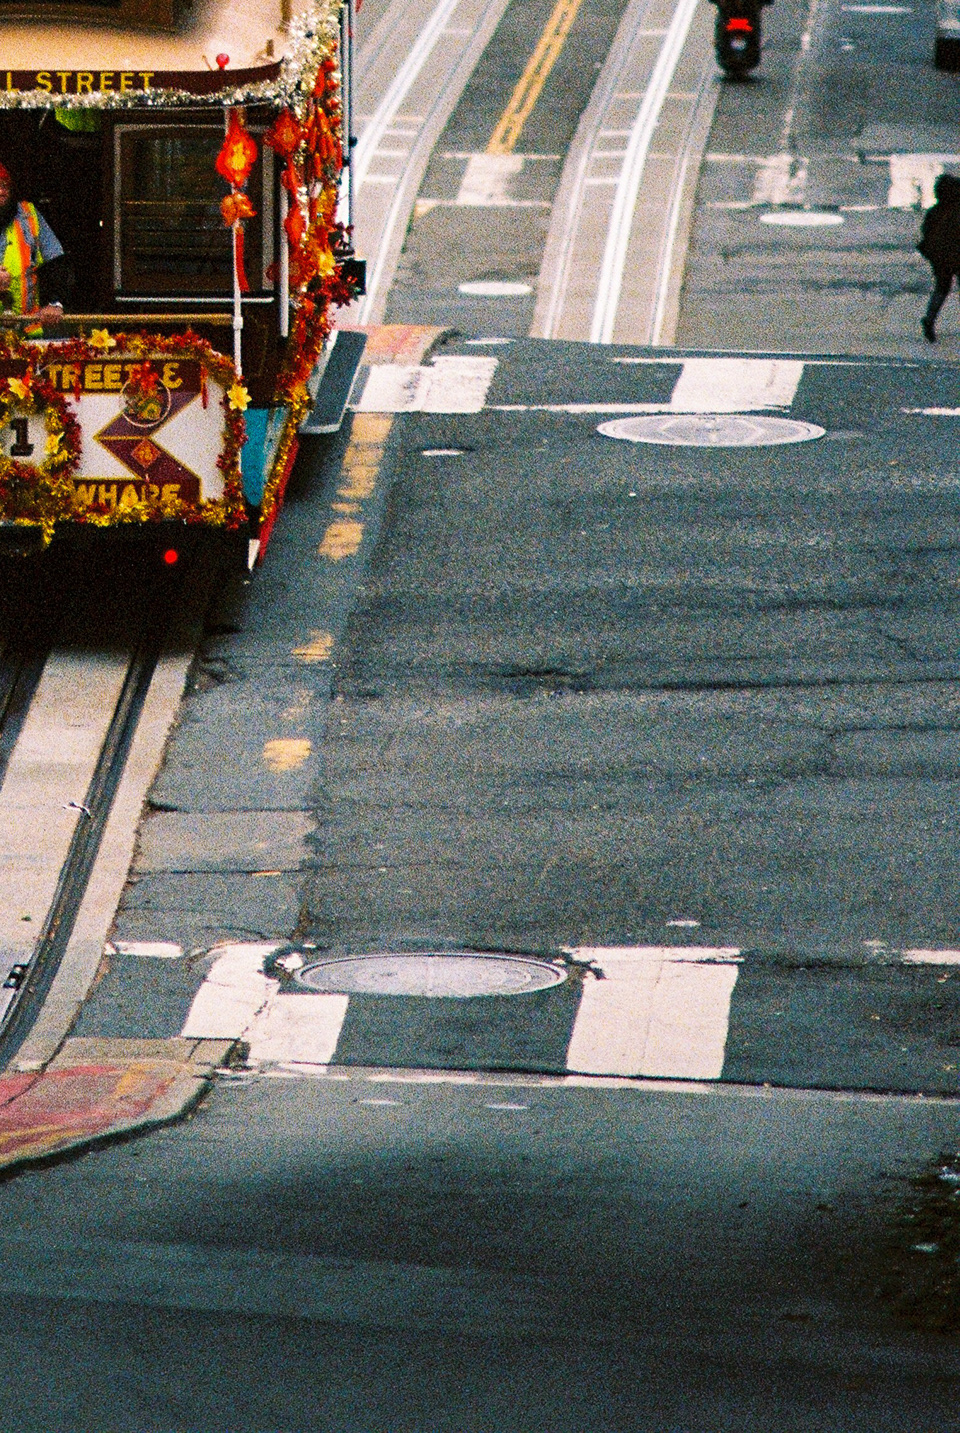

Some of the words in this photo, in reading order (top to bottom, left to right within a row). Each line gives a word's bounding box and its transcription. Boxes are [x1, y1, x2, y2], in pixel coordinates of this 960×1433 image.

[35, 71, 155, 93] STREET
[46, 363, 143, 389] TREET
[10, 417, 35, 457] 1
